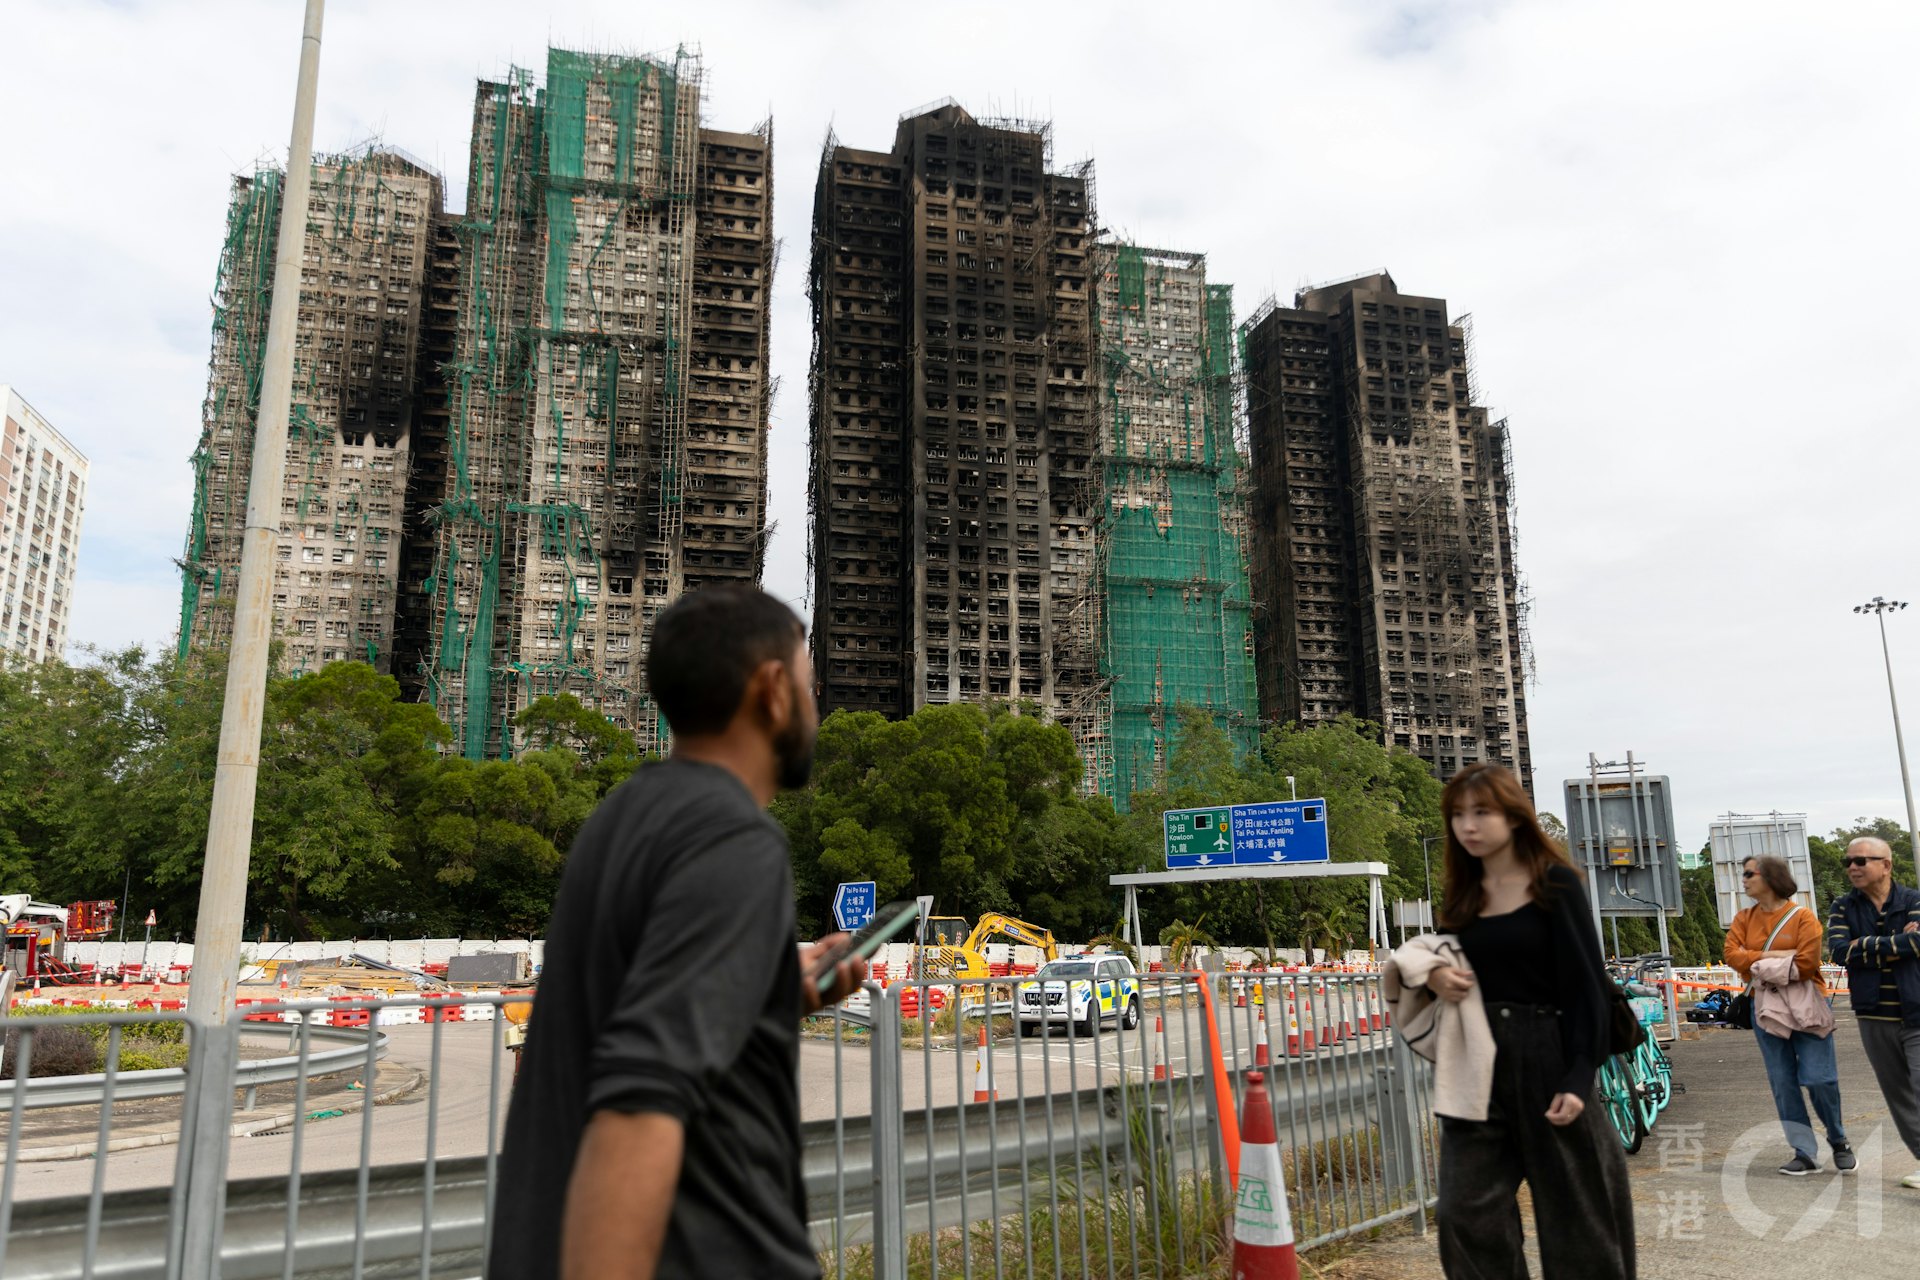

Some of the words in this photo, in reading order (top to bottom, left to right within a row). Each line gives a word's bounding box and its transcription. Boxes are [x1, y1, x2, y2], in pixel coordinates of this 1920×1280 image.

[1169, 824, 1186, 834] 沙田
[1235, 829, 1245, 837] Tai
[1270, 827, 1294, 835] Fanling
[1169, 833, 1194, 841] Kowloon
[1170, 843, 1188, 854] 九龍
[846, 916, 859, 925] 沙田
